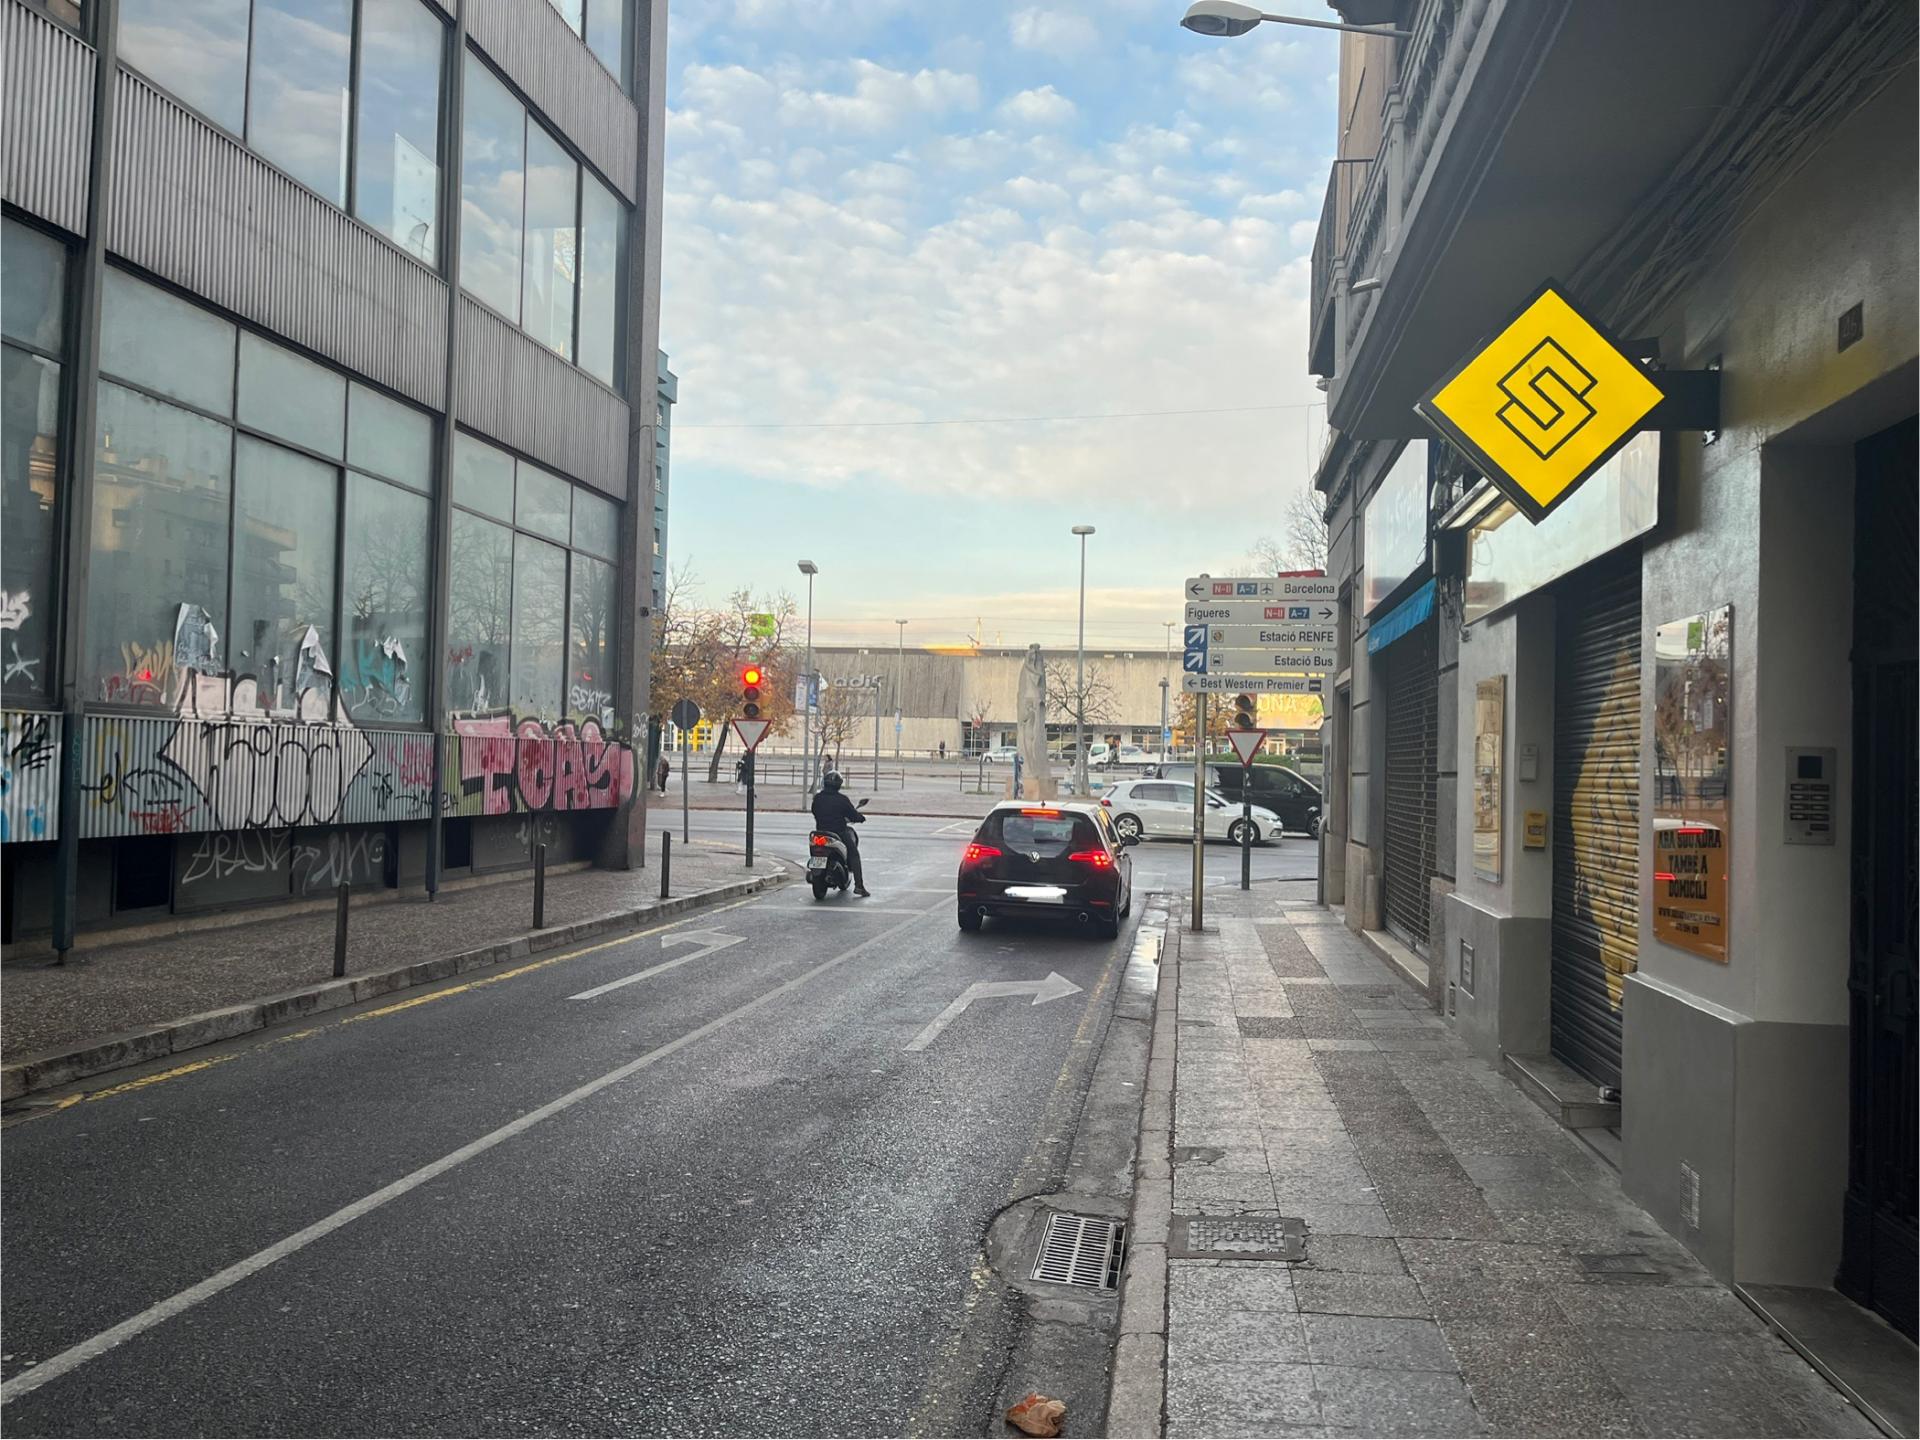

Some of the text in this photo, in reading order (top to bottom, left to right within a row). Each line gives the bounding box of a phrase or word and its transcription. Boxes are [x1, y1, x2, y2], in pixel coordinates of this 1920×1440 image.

[1214, 583, 1335, 595] N-II A-7 Barcelona
[1188, 607, 1308, 620] Figueres N-II A-7
[1259, 631, 1334, 642] Estació RENFE
[1274, 655, 1333, 667] Estació Bus
[1200, 678, 1305, 691] Best Western Premier
[1700, 855, 1708, 874] A
